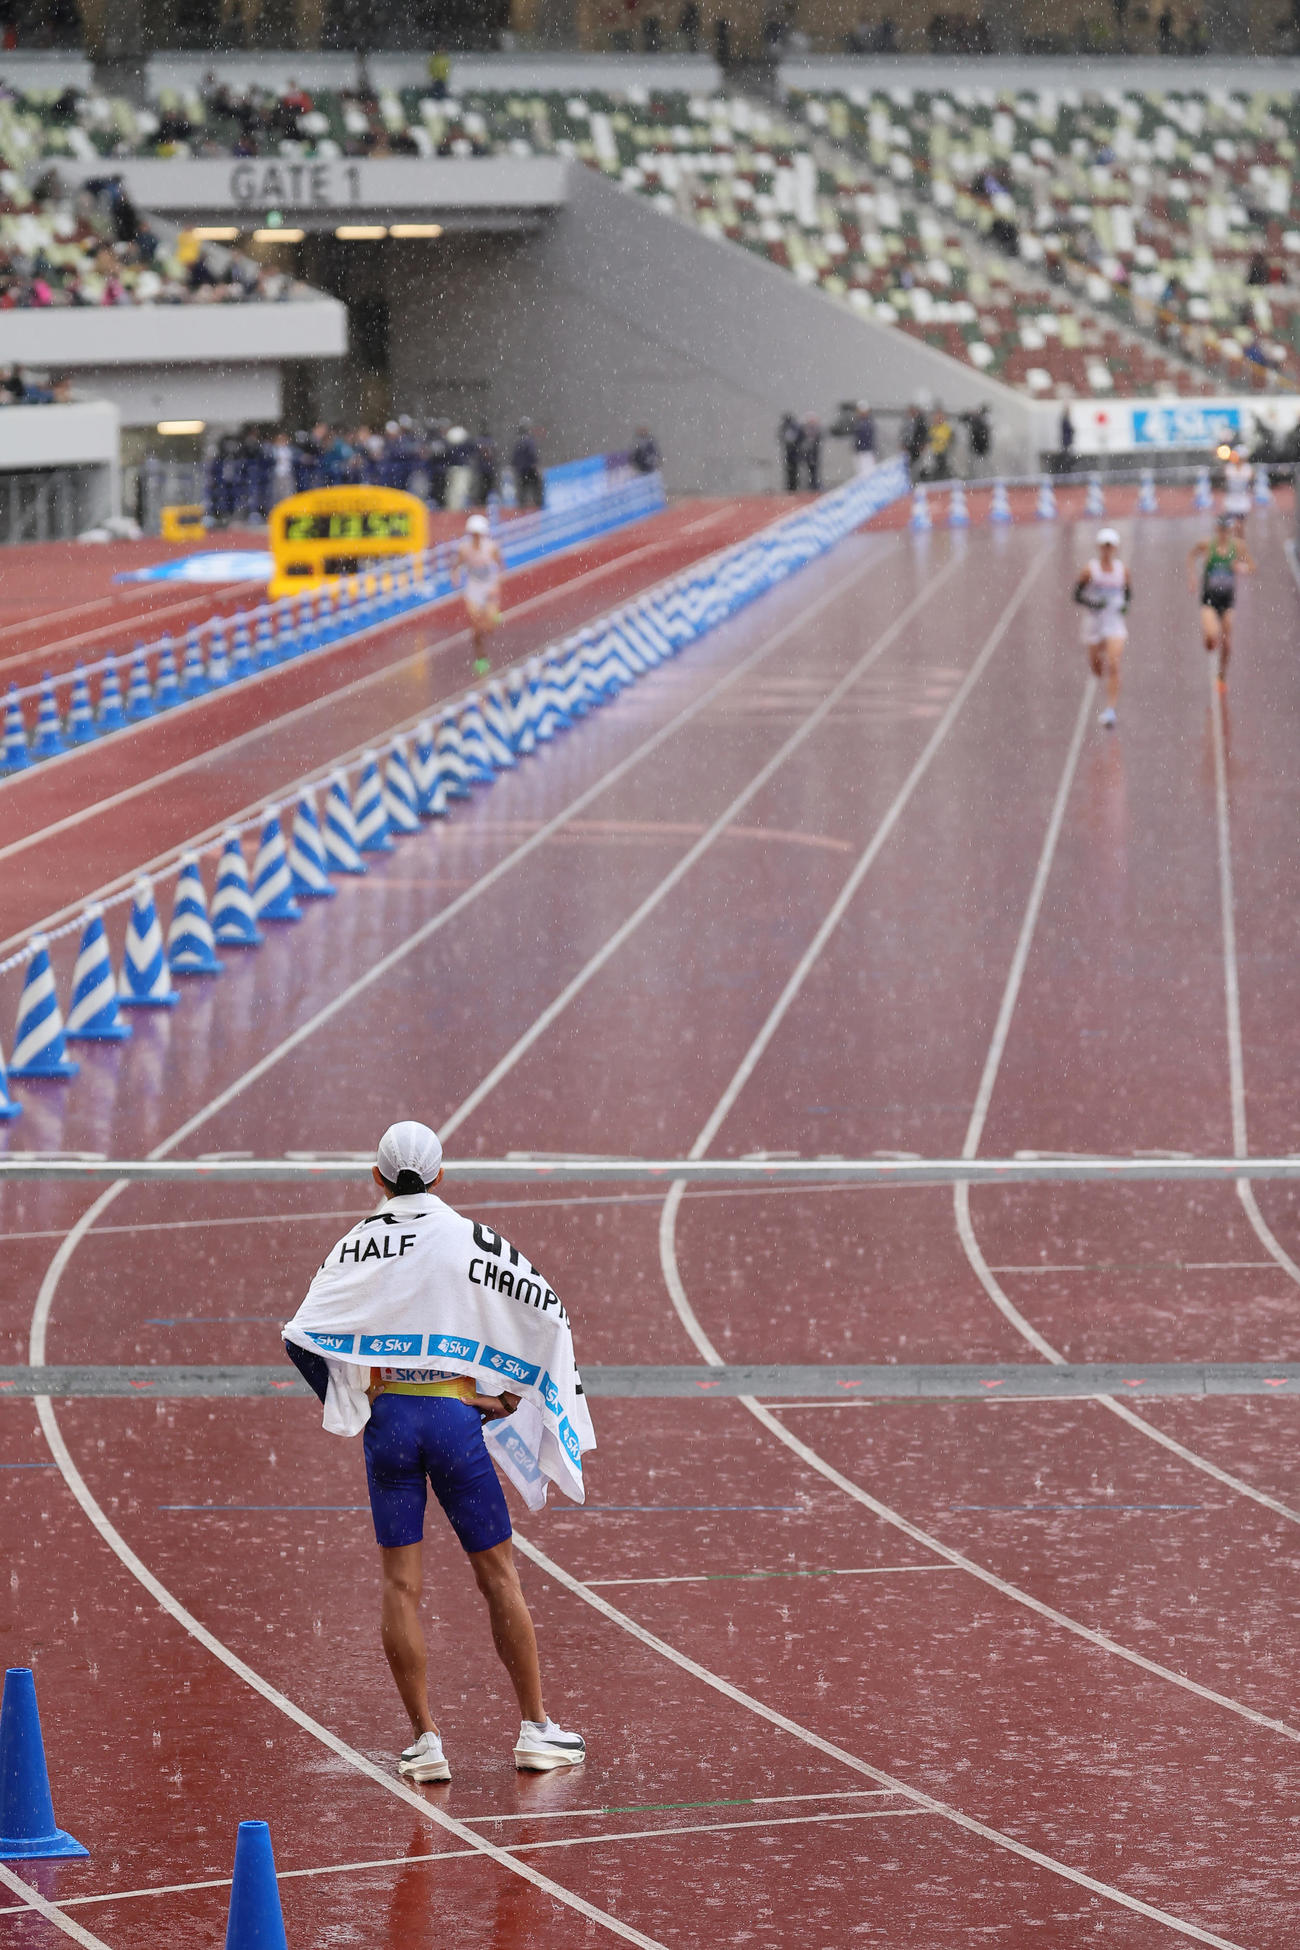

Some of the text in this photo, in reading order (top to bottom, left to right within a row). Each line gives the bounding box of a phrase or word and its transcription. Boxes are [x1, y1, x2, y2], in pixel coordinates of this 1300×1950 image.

[230, 164, 361, 206] GATE 1
[339, 1234, 417, 1263] HALF
[384, 1339, 412, 1353] Sky
[449, 1340, 470, 1357] Sky
[502, 1359, 530, 1381] Sky
